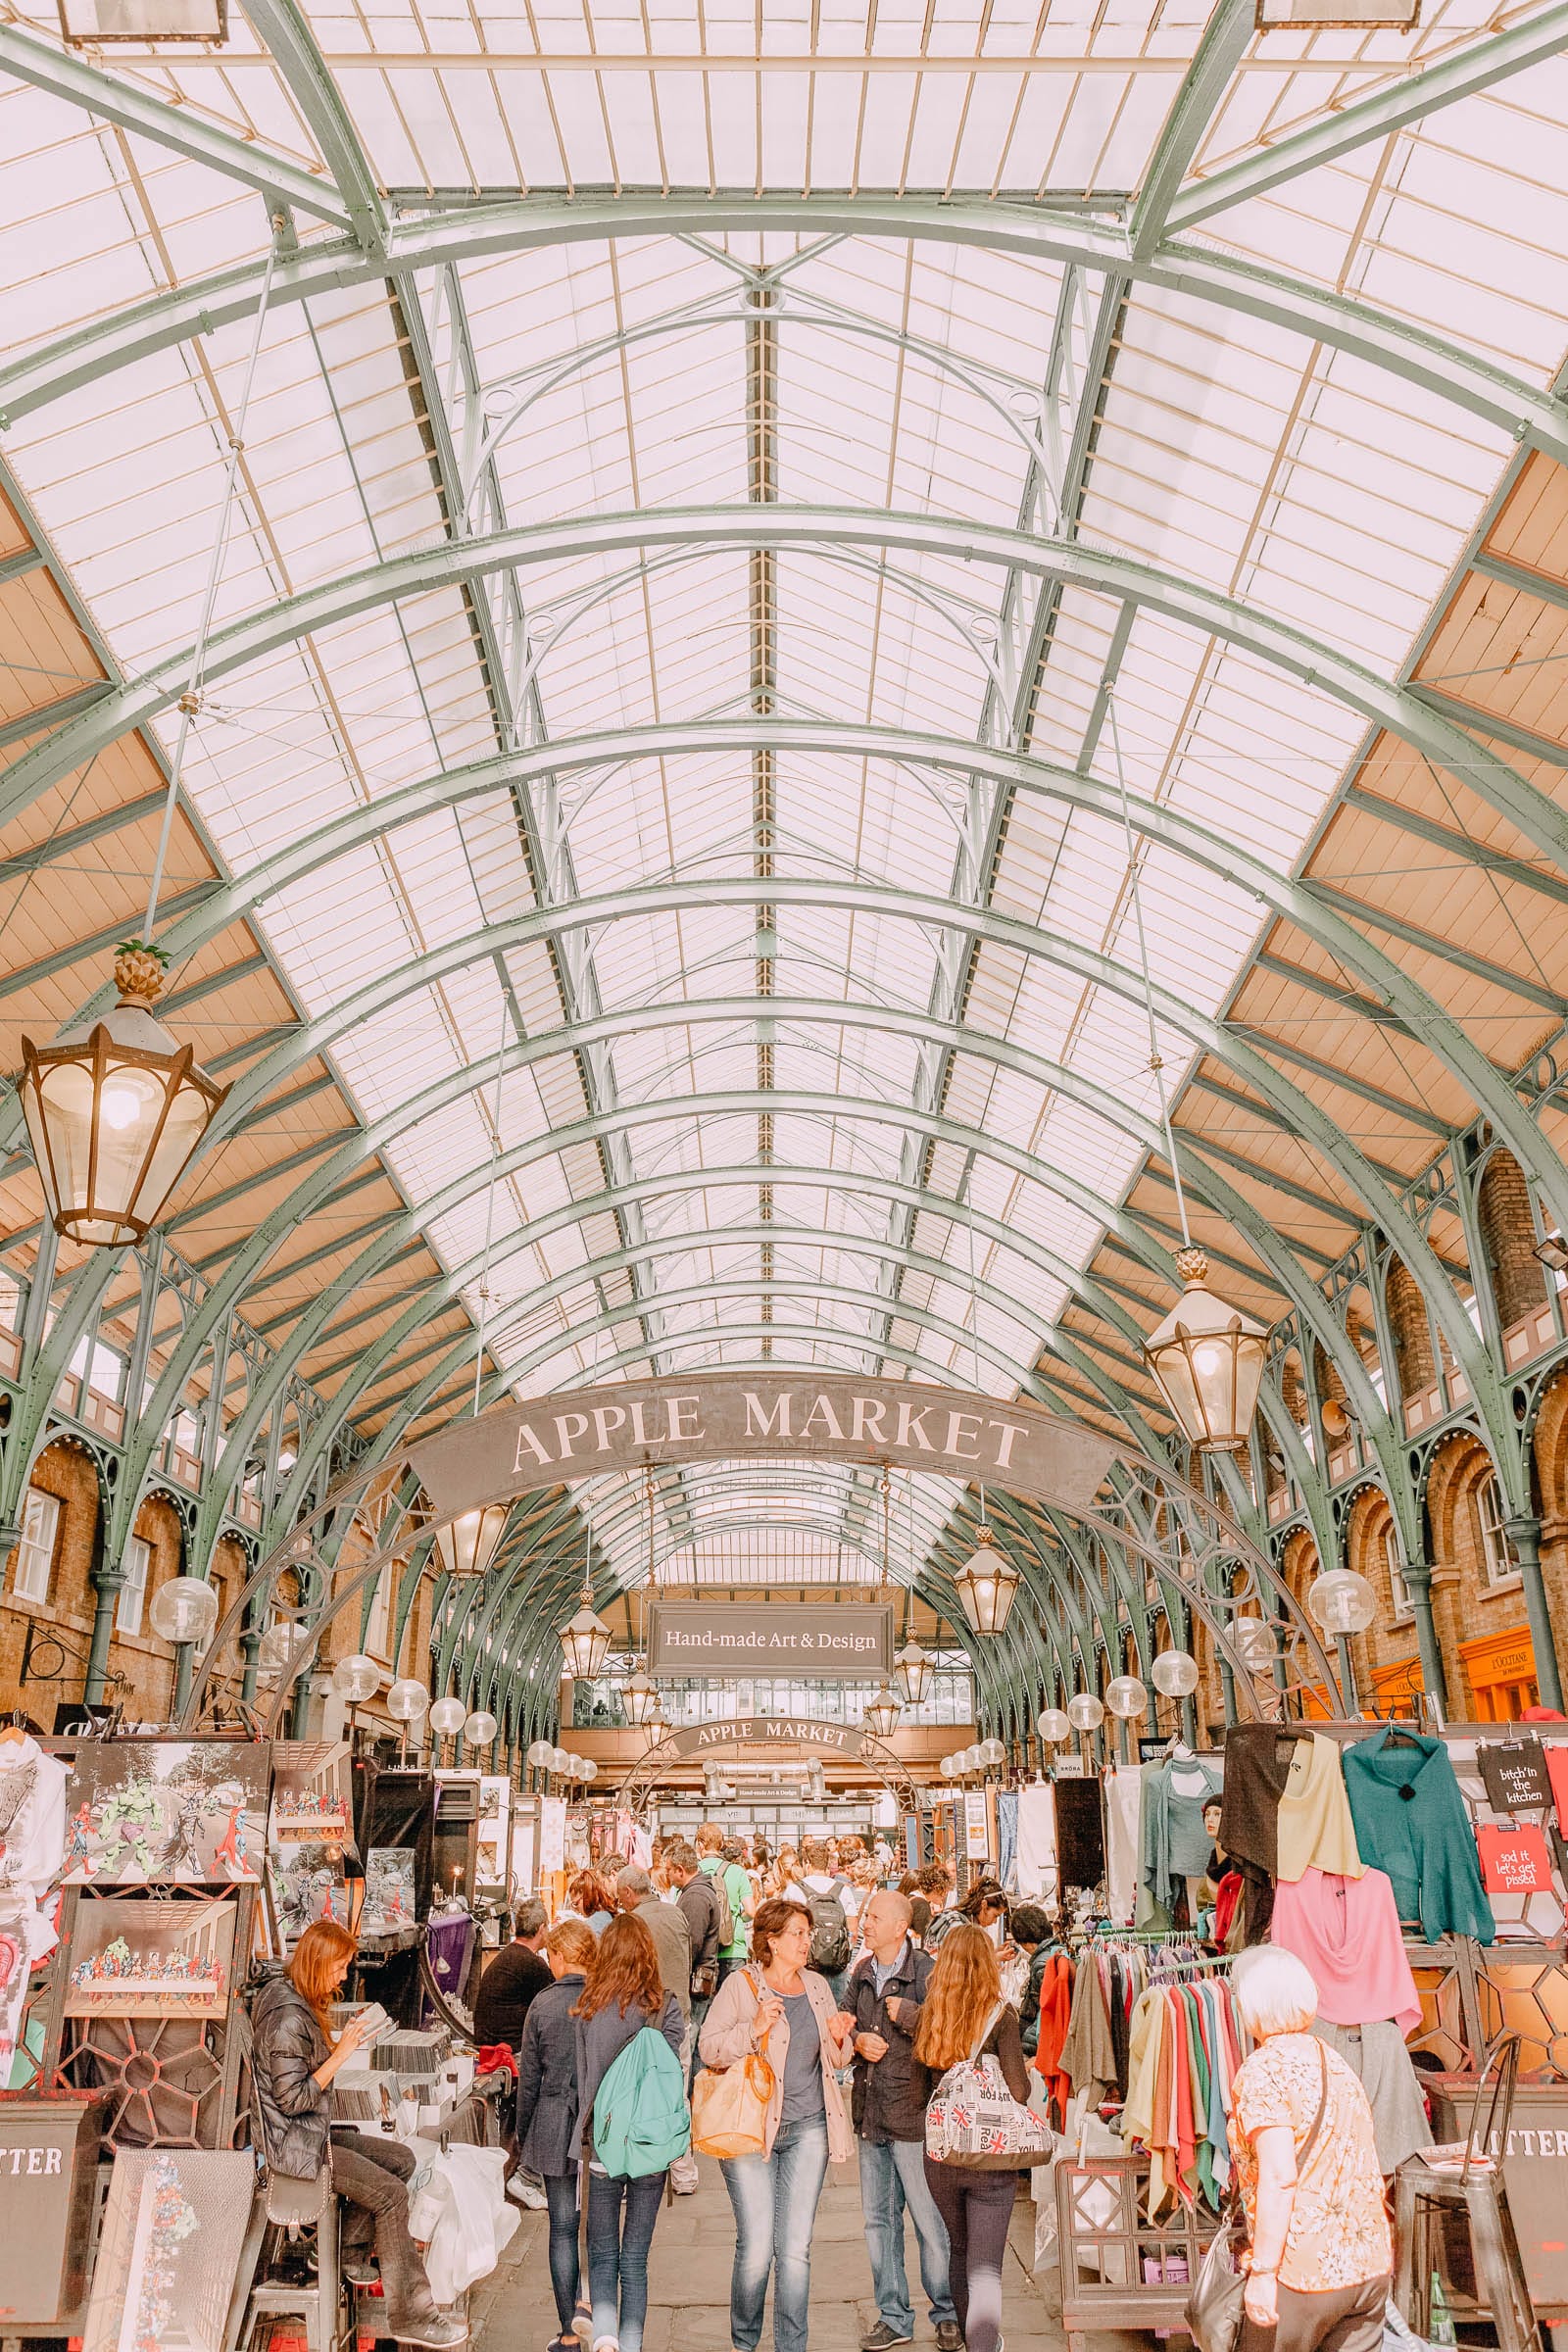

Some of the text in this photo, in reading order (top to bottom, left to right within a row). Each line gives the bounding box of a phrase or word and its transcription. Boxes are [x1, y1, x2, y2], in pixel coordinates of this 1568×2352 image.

[512, 1393, 1030, 1474] APPLE MARKET
[664, 1631, 877, 1651] Hand-made Art & Design
[698, 1722, 848, 1746] APPLE MARKET
[1513, 1779, 1531, 1790] the
[1506, 1789, 1543, 1803] kitchen
[1500, 1850, 1531, 1863] sod it
[1495, 1861, 1538, 1878] let's get
[1505, 1871, 1538, 1889] pissed
